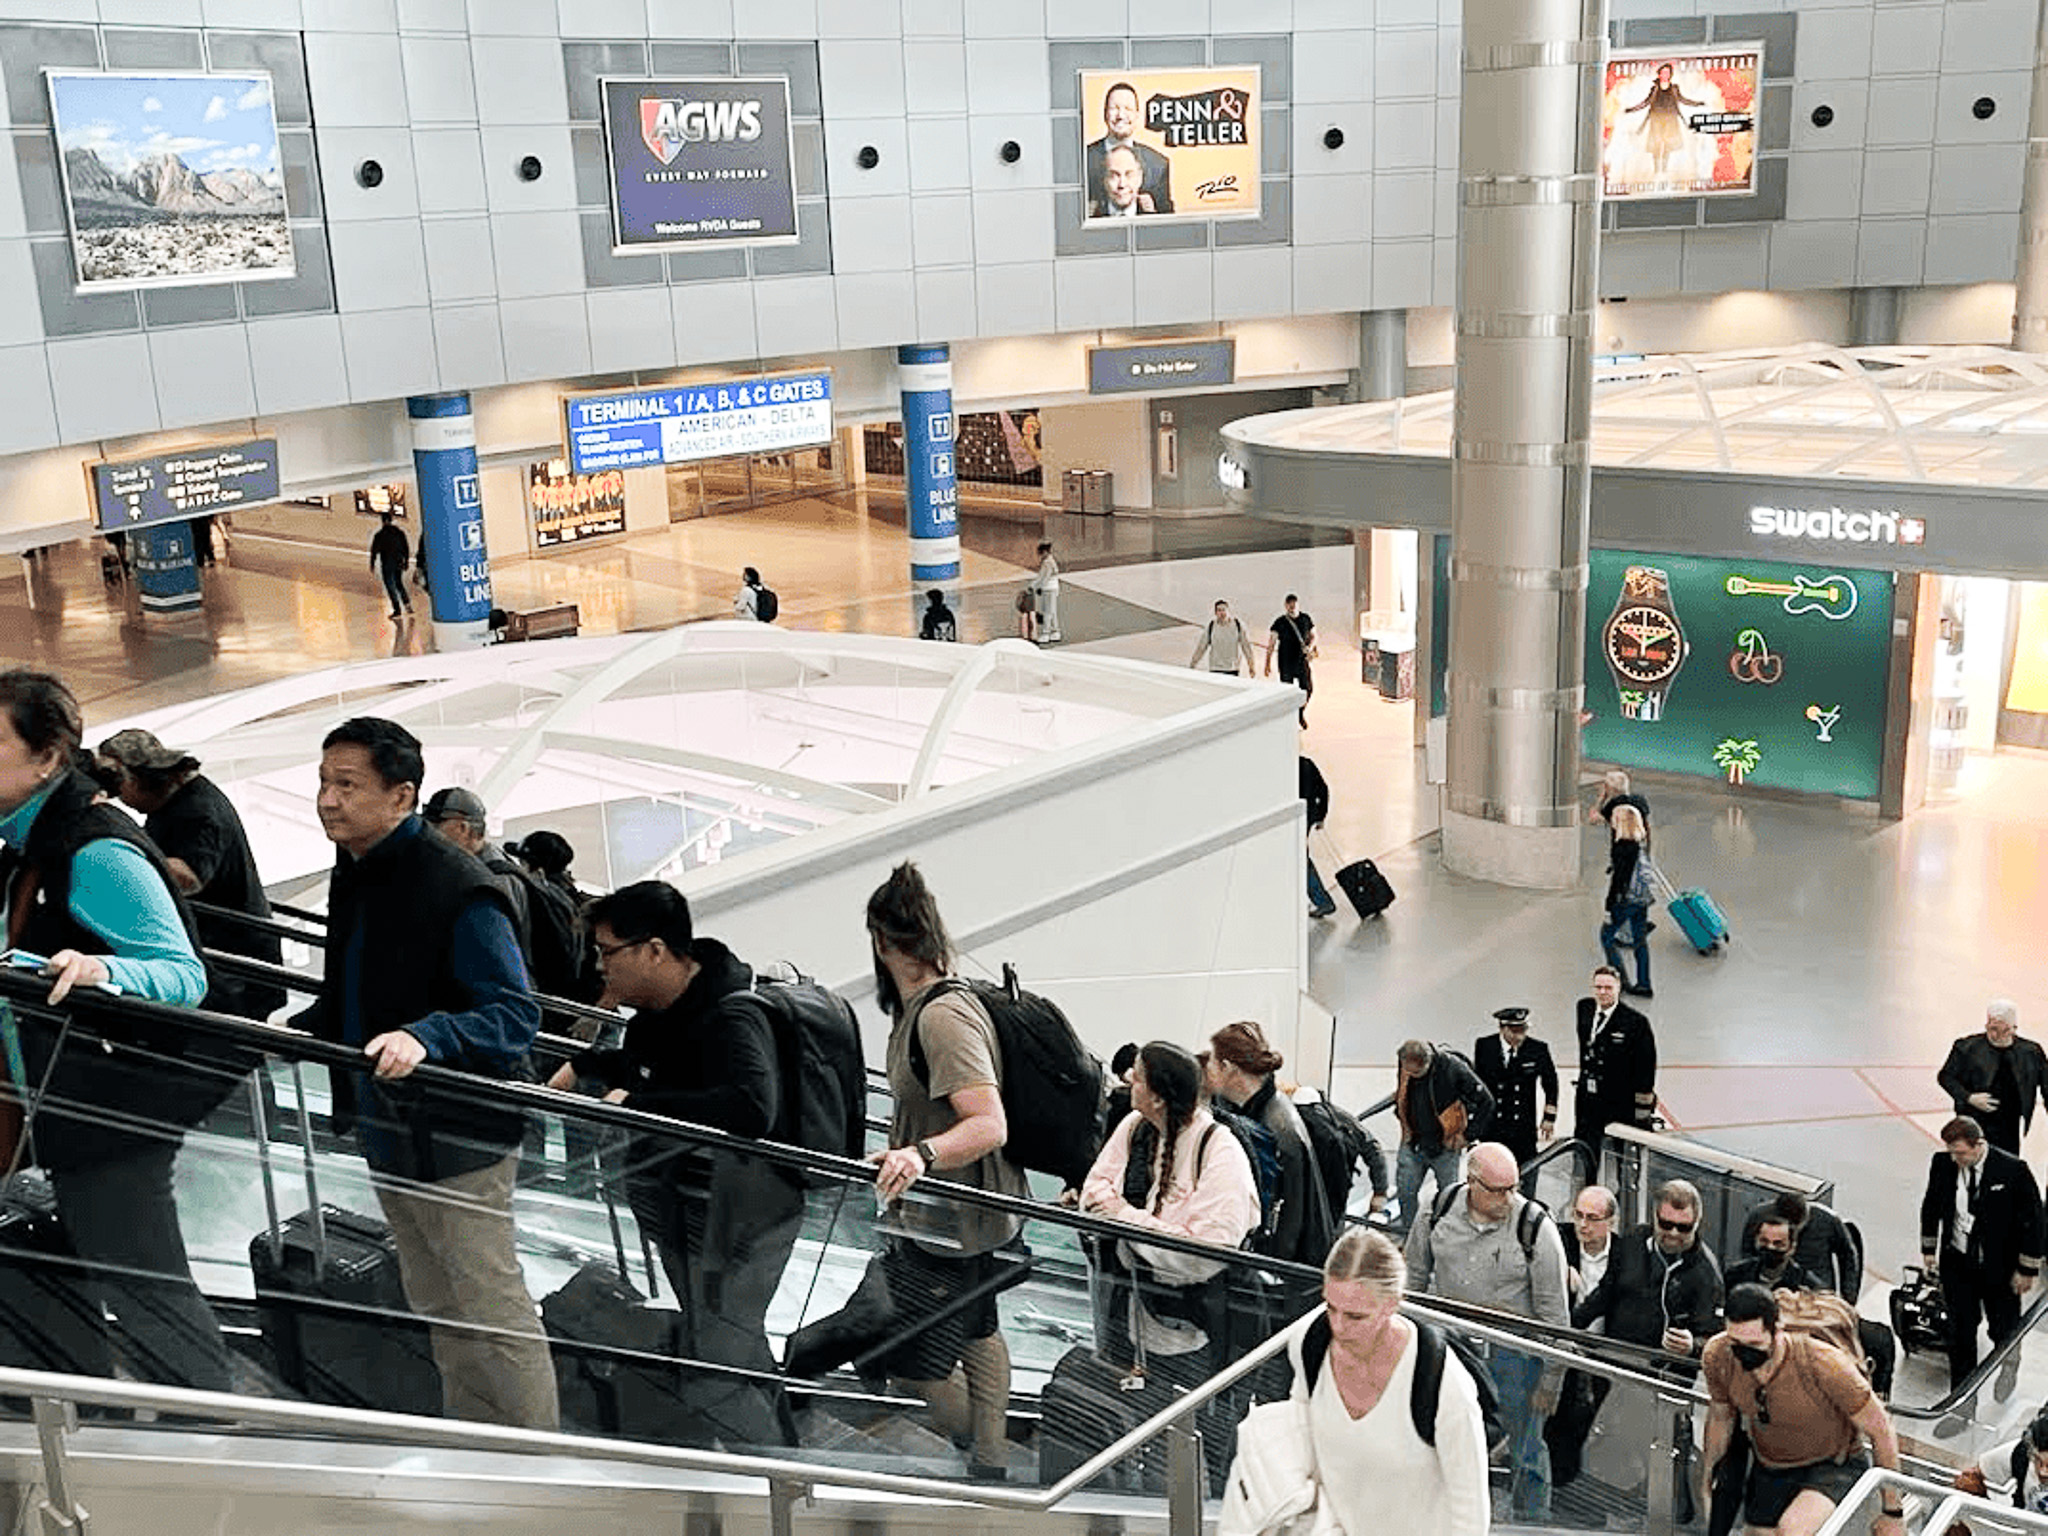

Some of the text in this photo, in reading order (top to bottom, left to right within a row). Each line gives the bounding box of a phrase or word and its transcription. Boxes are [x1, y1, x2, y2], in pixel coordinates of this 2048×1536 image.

[653, 100, 762, 142] AGWS
[1149, 89, 1243, 123] PENN &
[1170, 122, 1243, 145] TELLER
[655, 222, 698, 234] Welcome
[730, 218, 761, 231] Guests
[579, 397, 670, 425] TERMINAL
[718, 390, 735, 410] B,
[738, 387, 752, 406] &
[753, 386, 766, 404] C
[770, 380, 824, 402] GATES
[679, 412, 756, 436] AMERICAN
[771, 405, 816, 425] DELTA
[929, 490, 956, 506] BLUE
[932, 505, 956, 524] LINE
[1750, 506, 1900, 544] swatch
